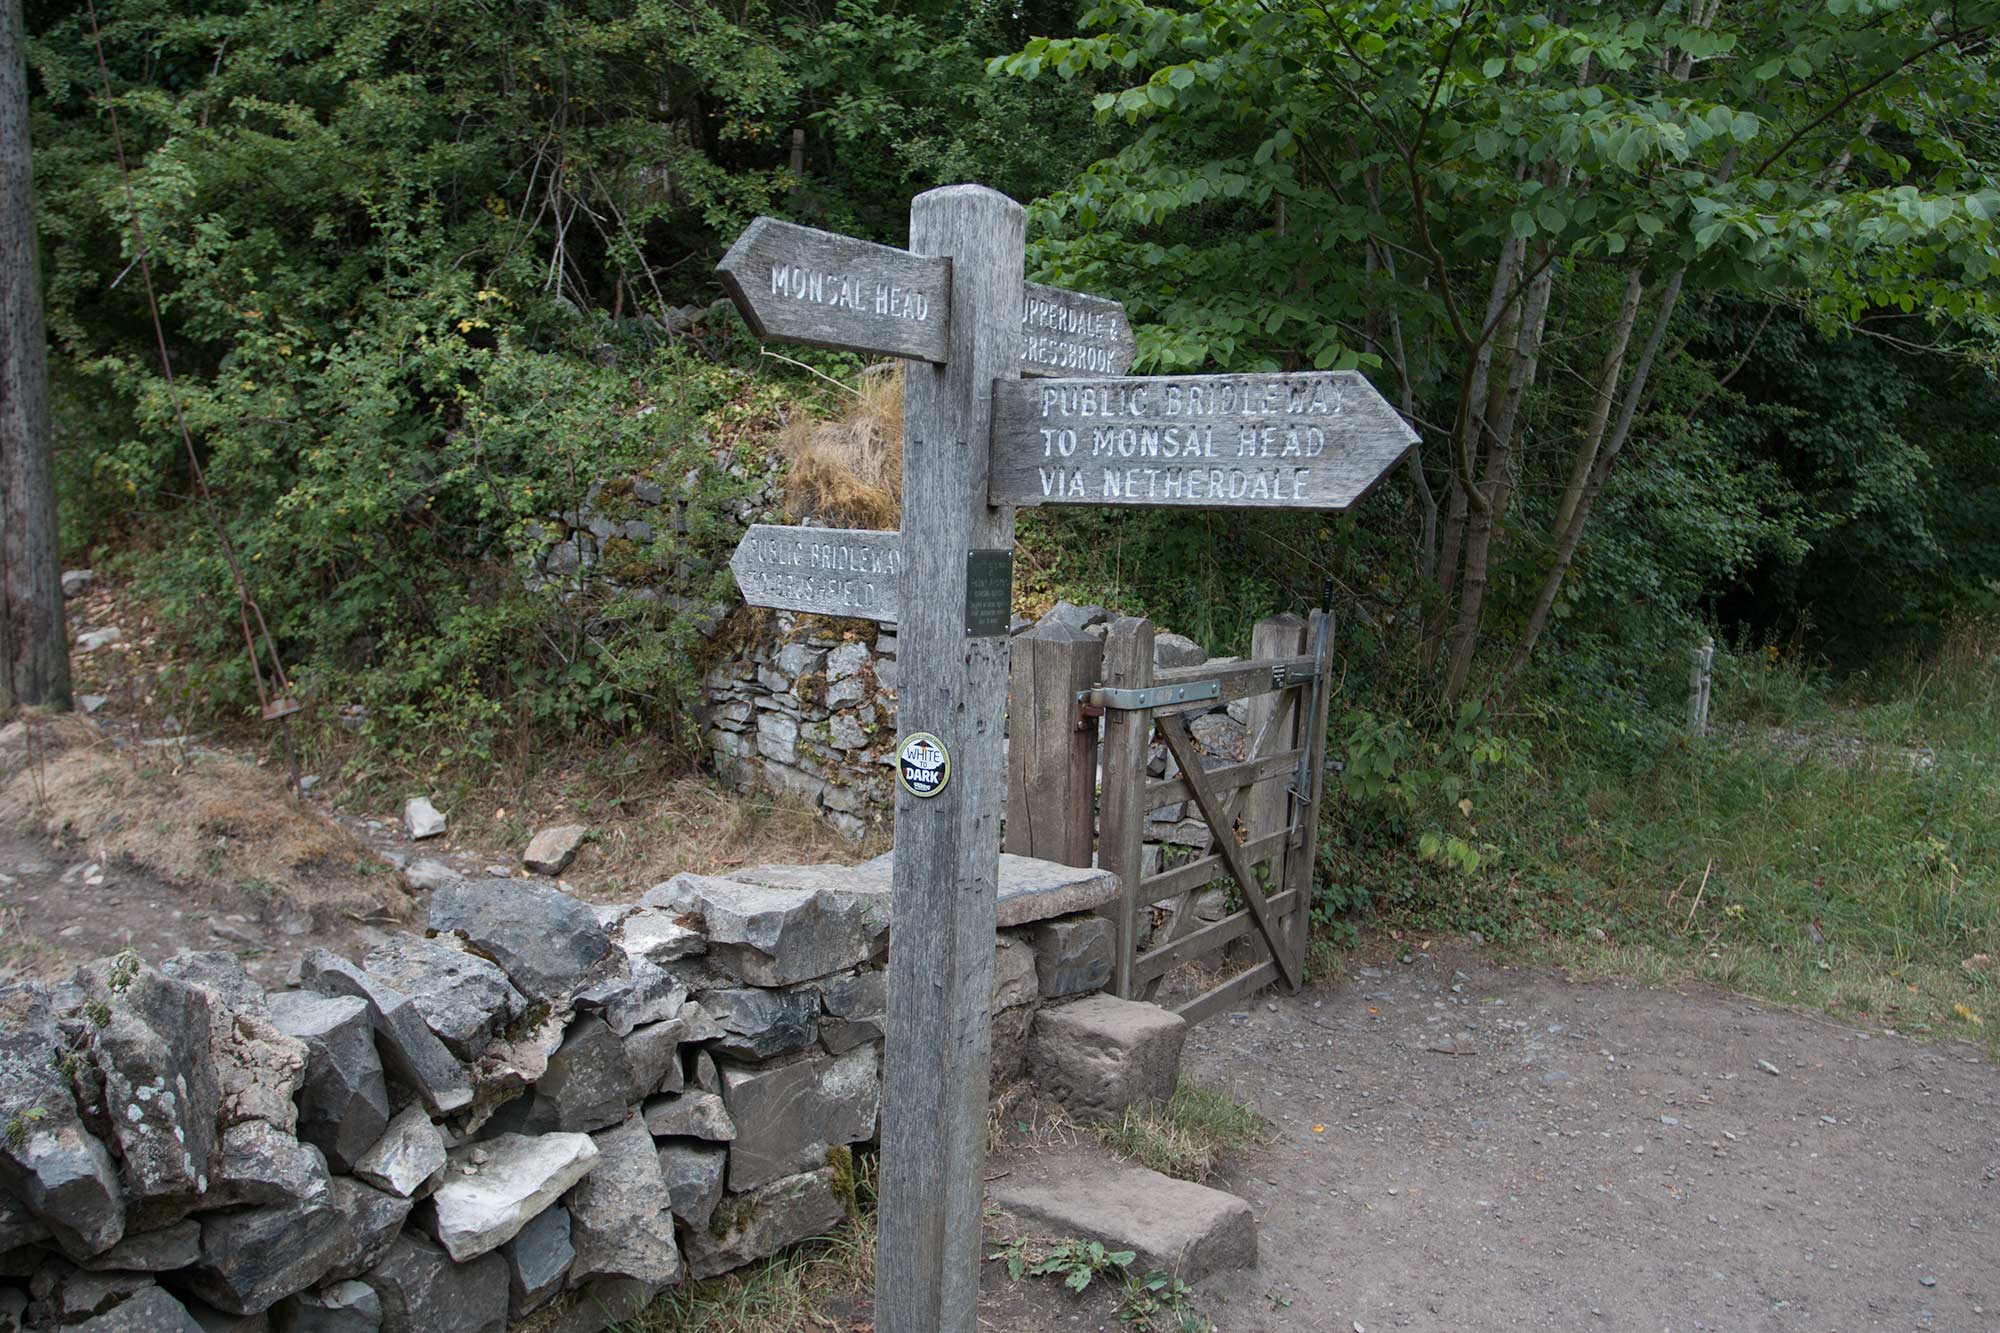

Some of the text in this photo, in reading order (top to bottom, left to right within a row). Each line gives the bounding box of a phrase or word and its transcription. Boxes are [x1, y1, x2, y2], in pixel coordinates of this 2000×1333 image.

[772, 264, 928, 321] MONSAL HEAD
[1042, 380, 1349, 417] PUBLIC BRIDLEWAY
[1040, 424, 1325, 458] TO MONSAL HEAD
[1039, 467, 1311, 500] VIA NETHERDALE
[750, 538, 803, 566] PUBLIC
[907, 747, 941, 763] WHITE
[906, 767, 939, 784] DARK
